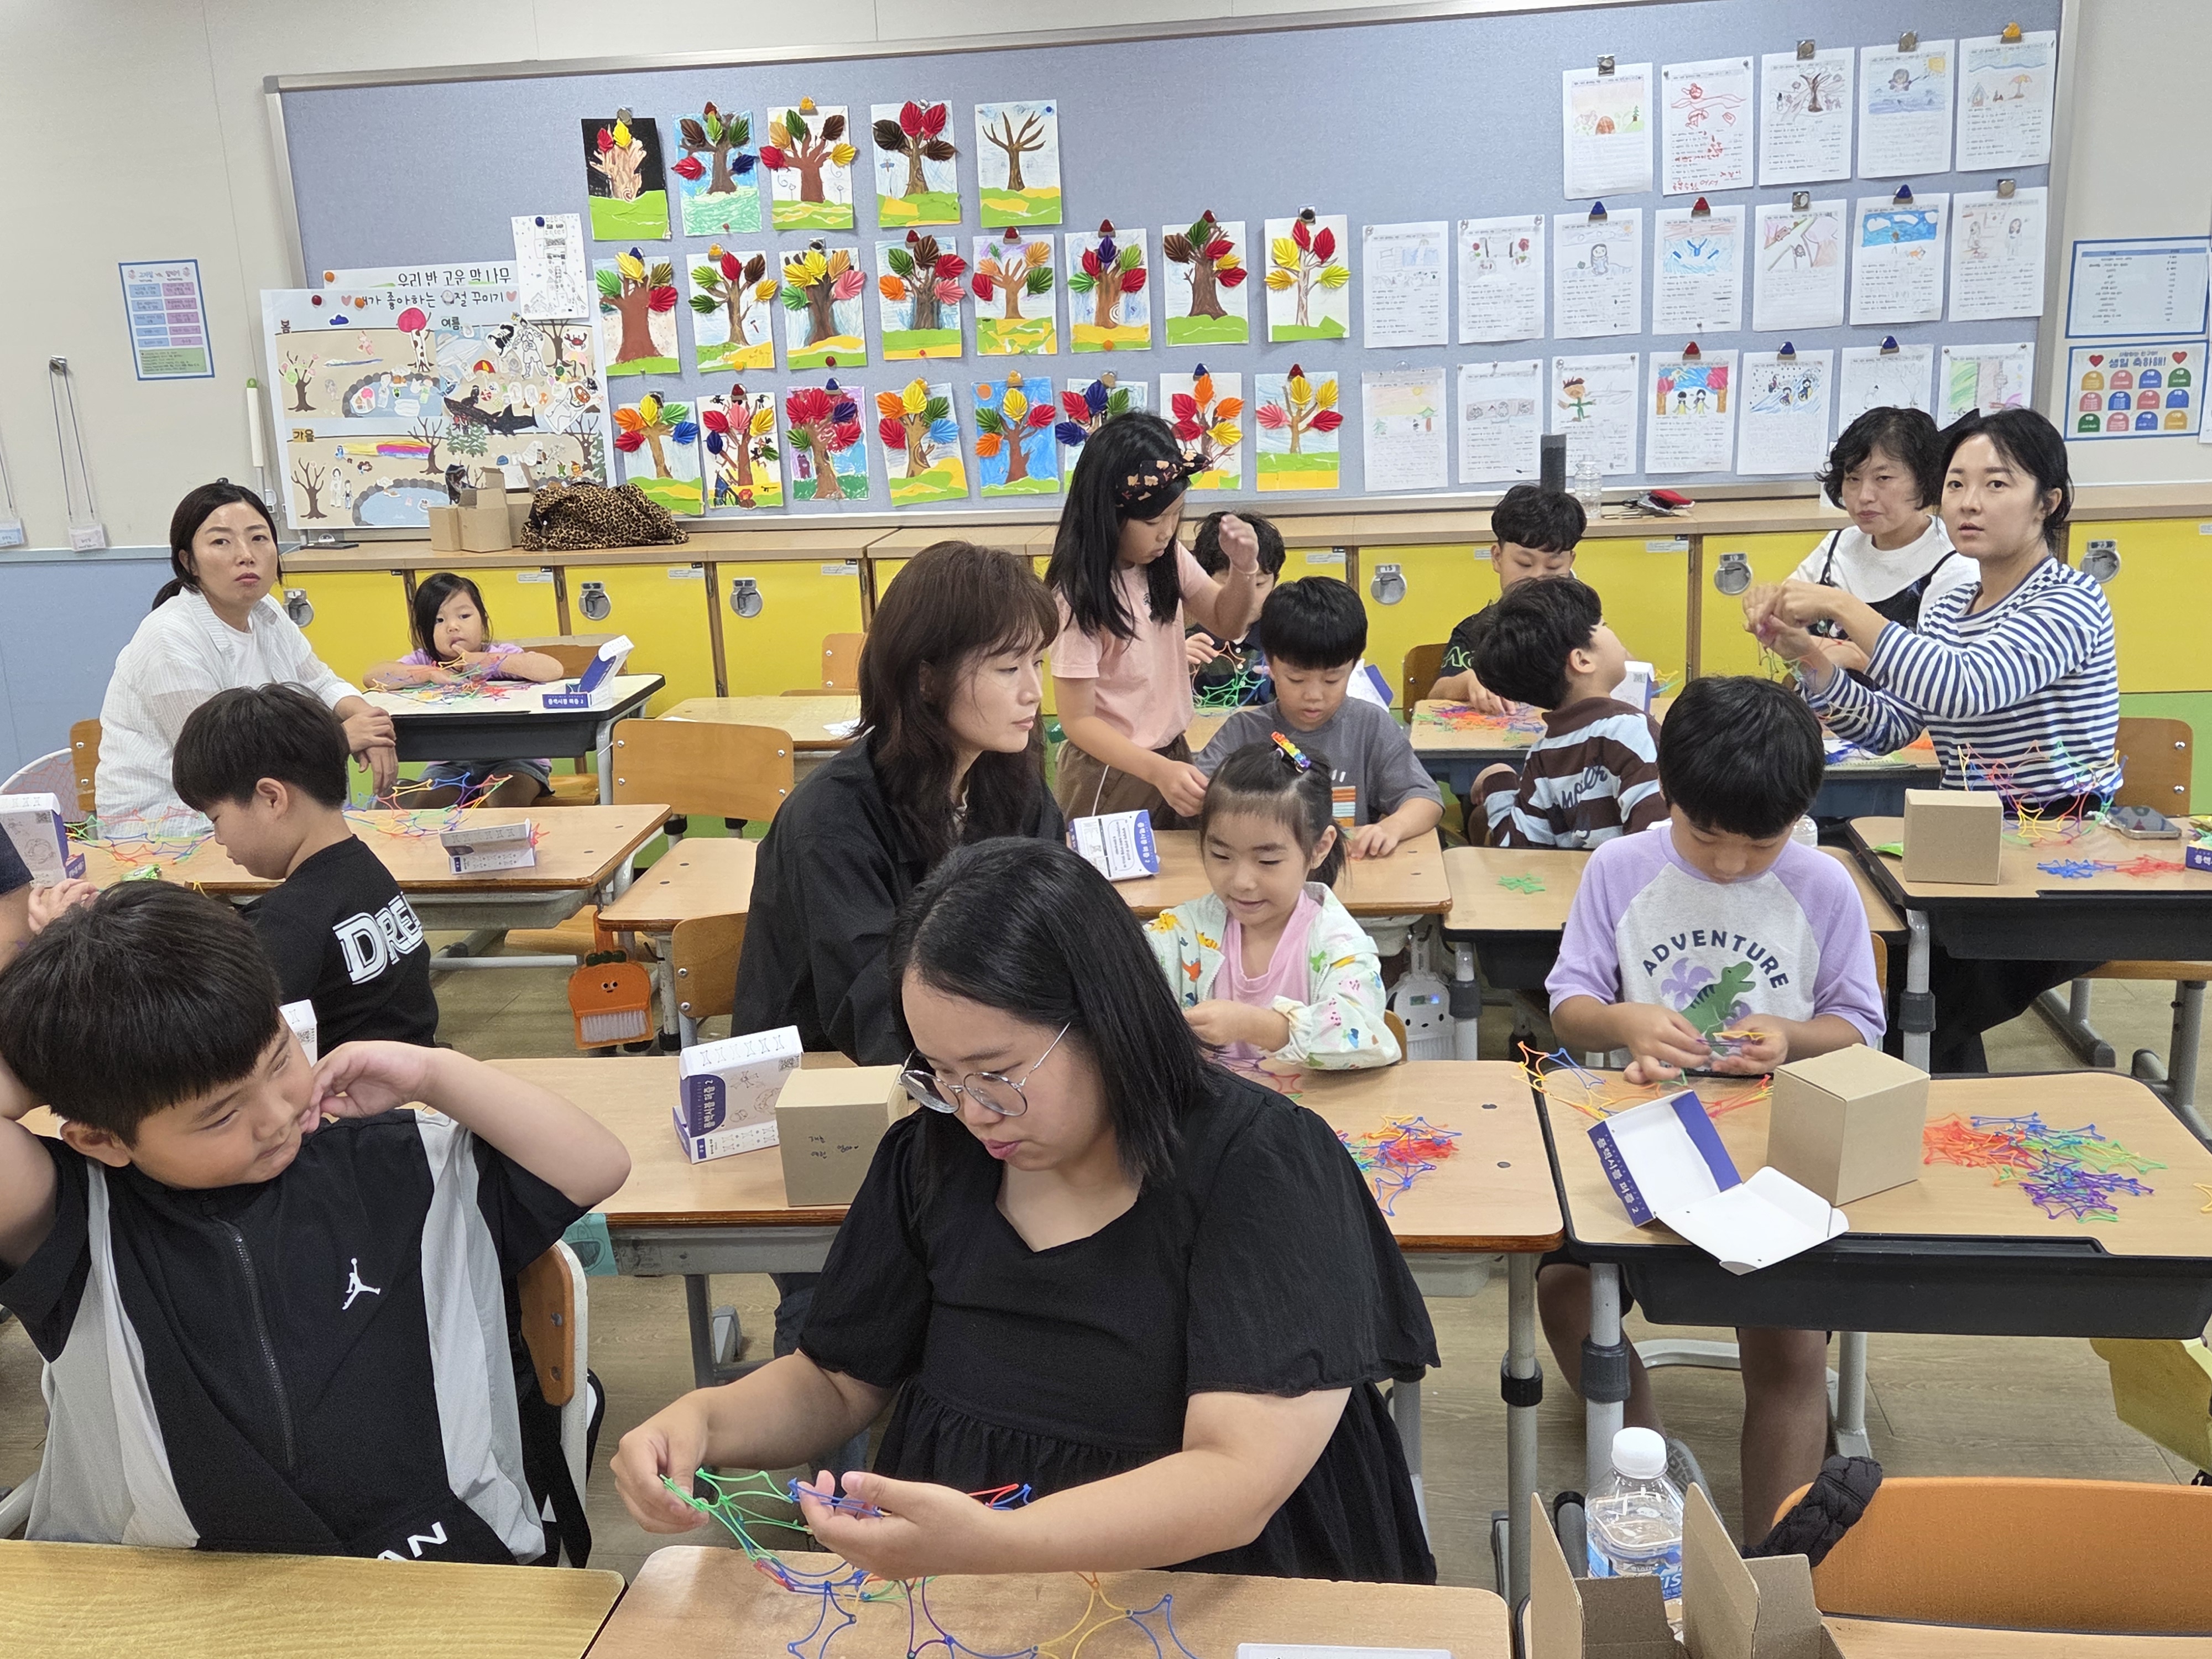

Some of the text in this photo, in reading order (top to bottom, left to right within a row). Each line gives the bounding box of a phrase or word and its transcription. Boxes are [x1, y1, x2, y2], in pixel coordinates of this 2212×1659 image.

[398, 272, 421, 287] 우리
[387, 291, 436, 310] 좋아하는
[281, 320, 291, 334] 봄
[441, 316, 460, 330] 여름
[2109, 358, 2129, 368] 생일
[293, 429, 315, 442] 가을
[2194, 854, 2212, 866] 플렉
[1642, 929, 1790, 989] ADVENTURE
[1597, 1138, 1623, 1180] 플렉시블
[1619, 1181, 1635, 1204] 퍼즐
[1661, 1573, 1682, 1589] IS
